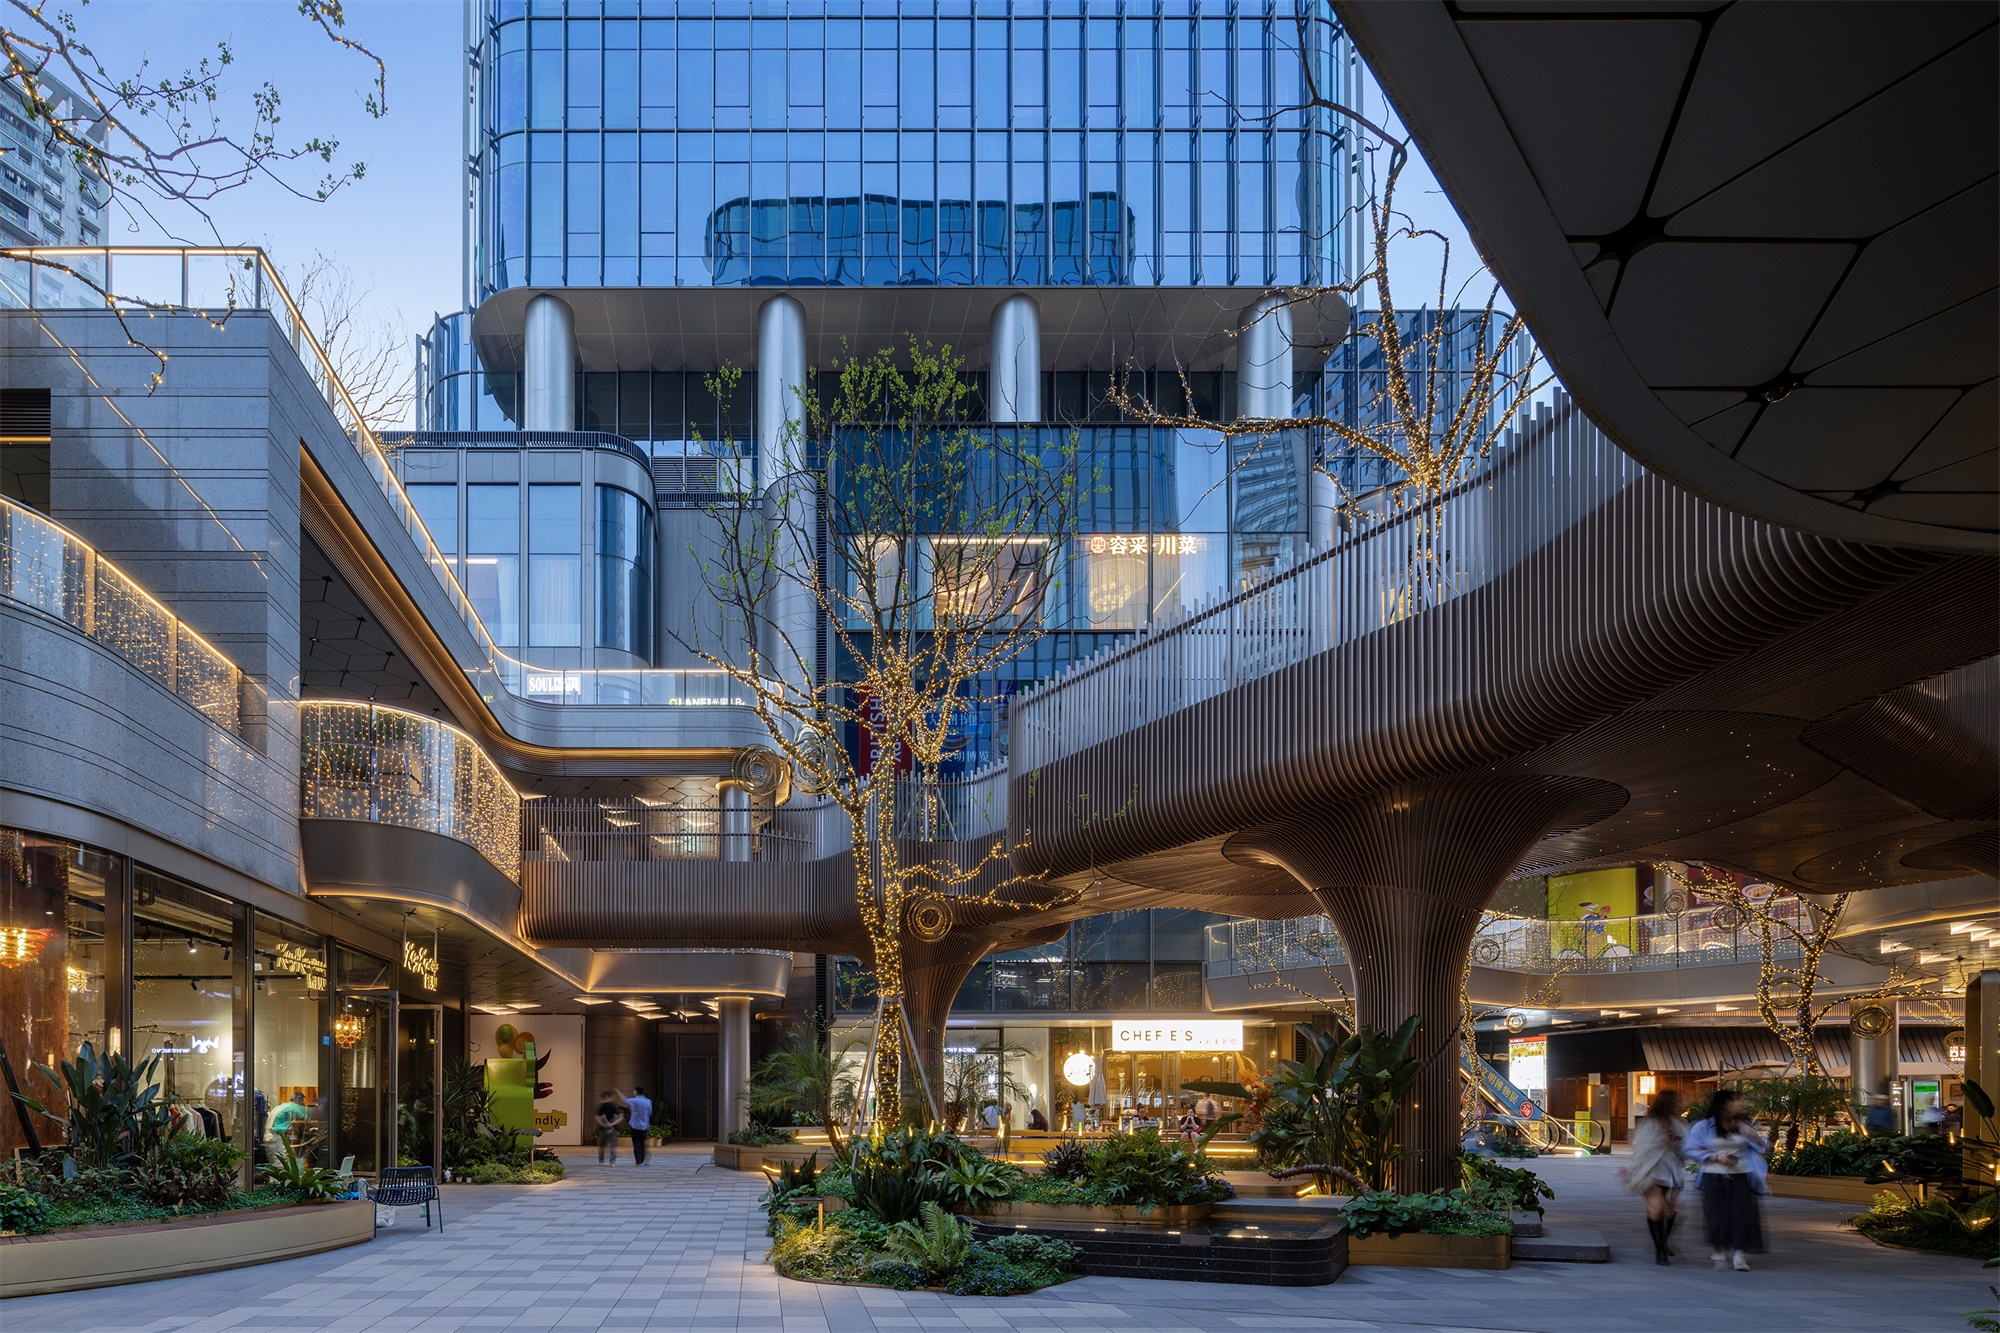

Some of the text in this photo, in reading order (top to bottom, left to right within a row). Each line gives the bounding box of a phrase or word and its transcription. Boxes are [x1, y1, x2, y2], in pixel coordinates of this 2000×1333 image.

[929, 713, 978, 726] 大图书馆
[1120, 1030, 1162, 1041] CHEF
